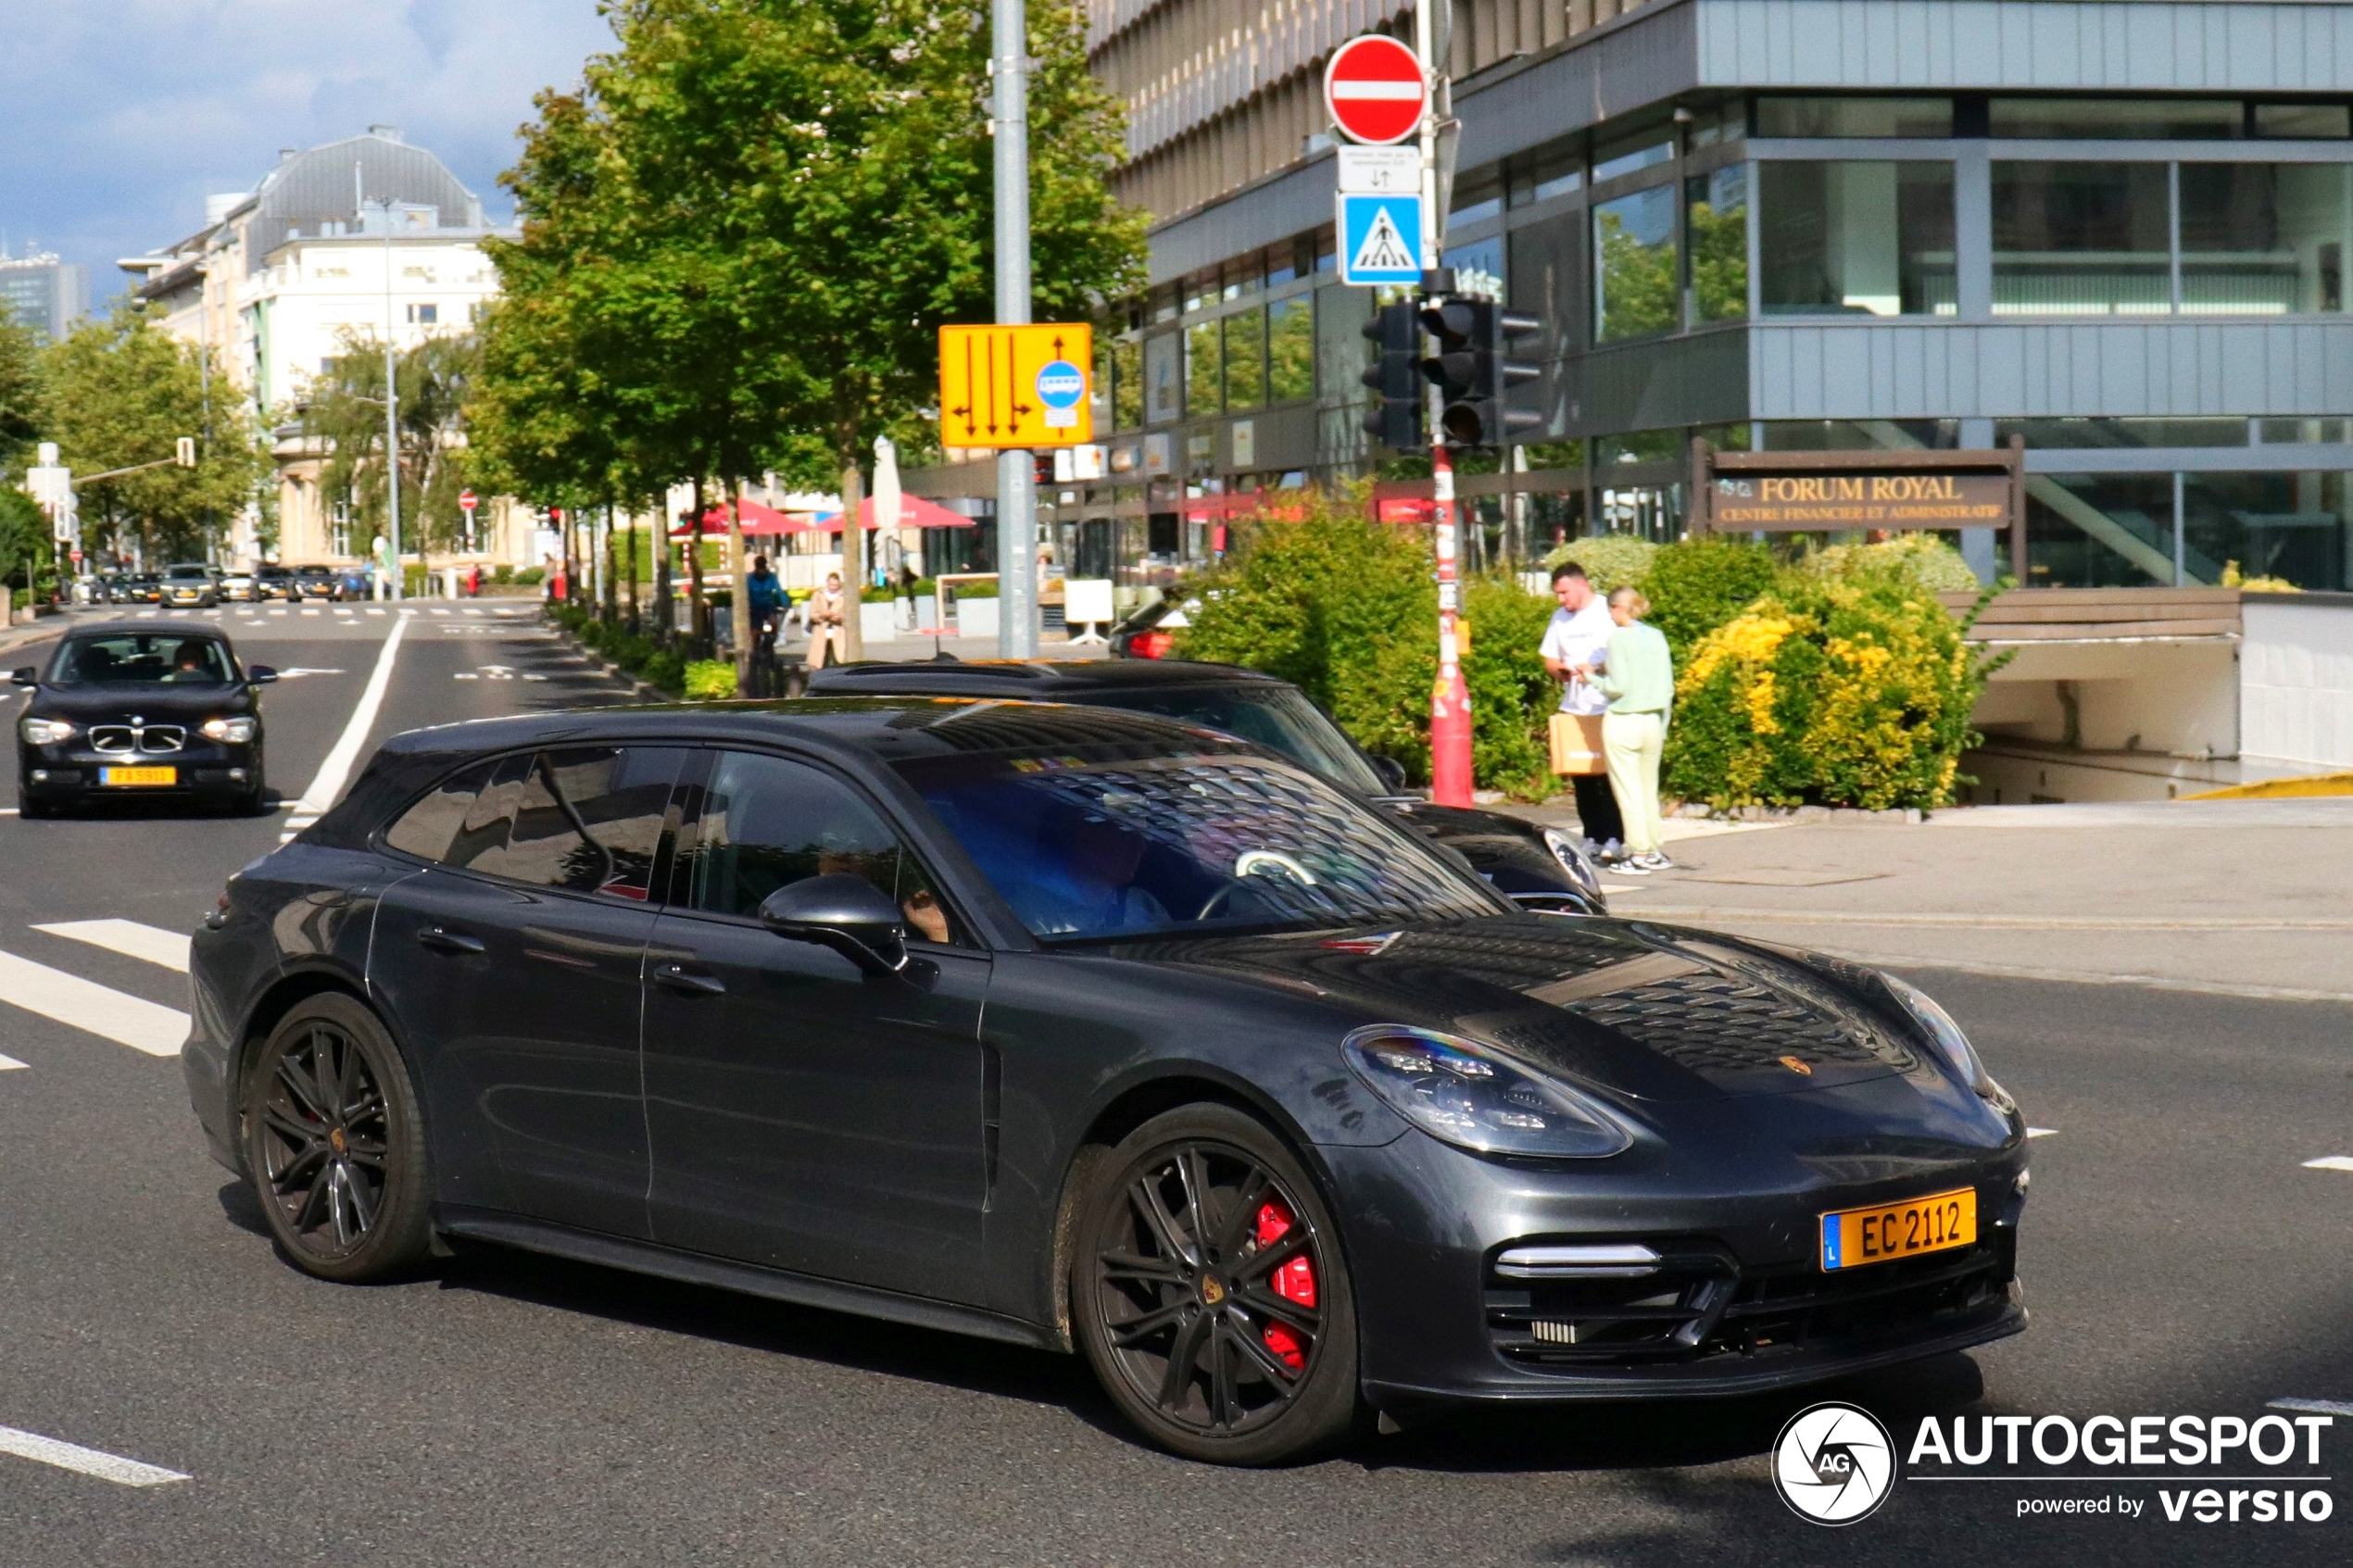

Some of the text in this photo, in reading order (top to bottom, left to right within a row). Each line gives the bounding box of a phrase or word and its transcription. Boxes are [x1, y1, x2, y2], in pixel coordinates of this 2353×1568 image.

[1760, 477, 1865, 503] FORUM
[1871, 475, 1963, 501] ROYAL
[1720, 505, 2002, 521] CENTRE FINANCIER ET ADMINISTRATIF
[1828, 1201, 1959, 1261] L EC 2112
